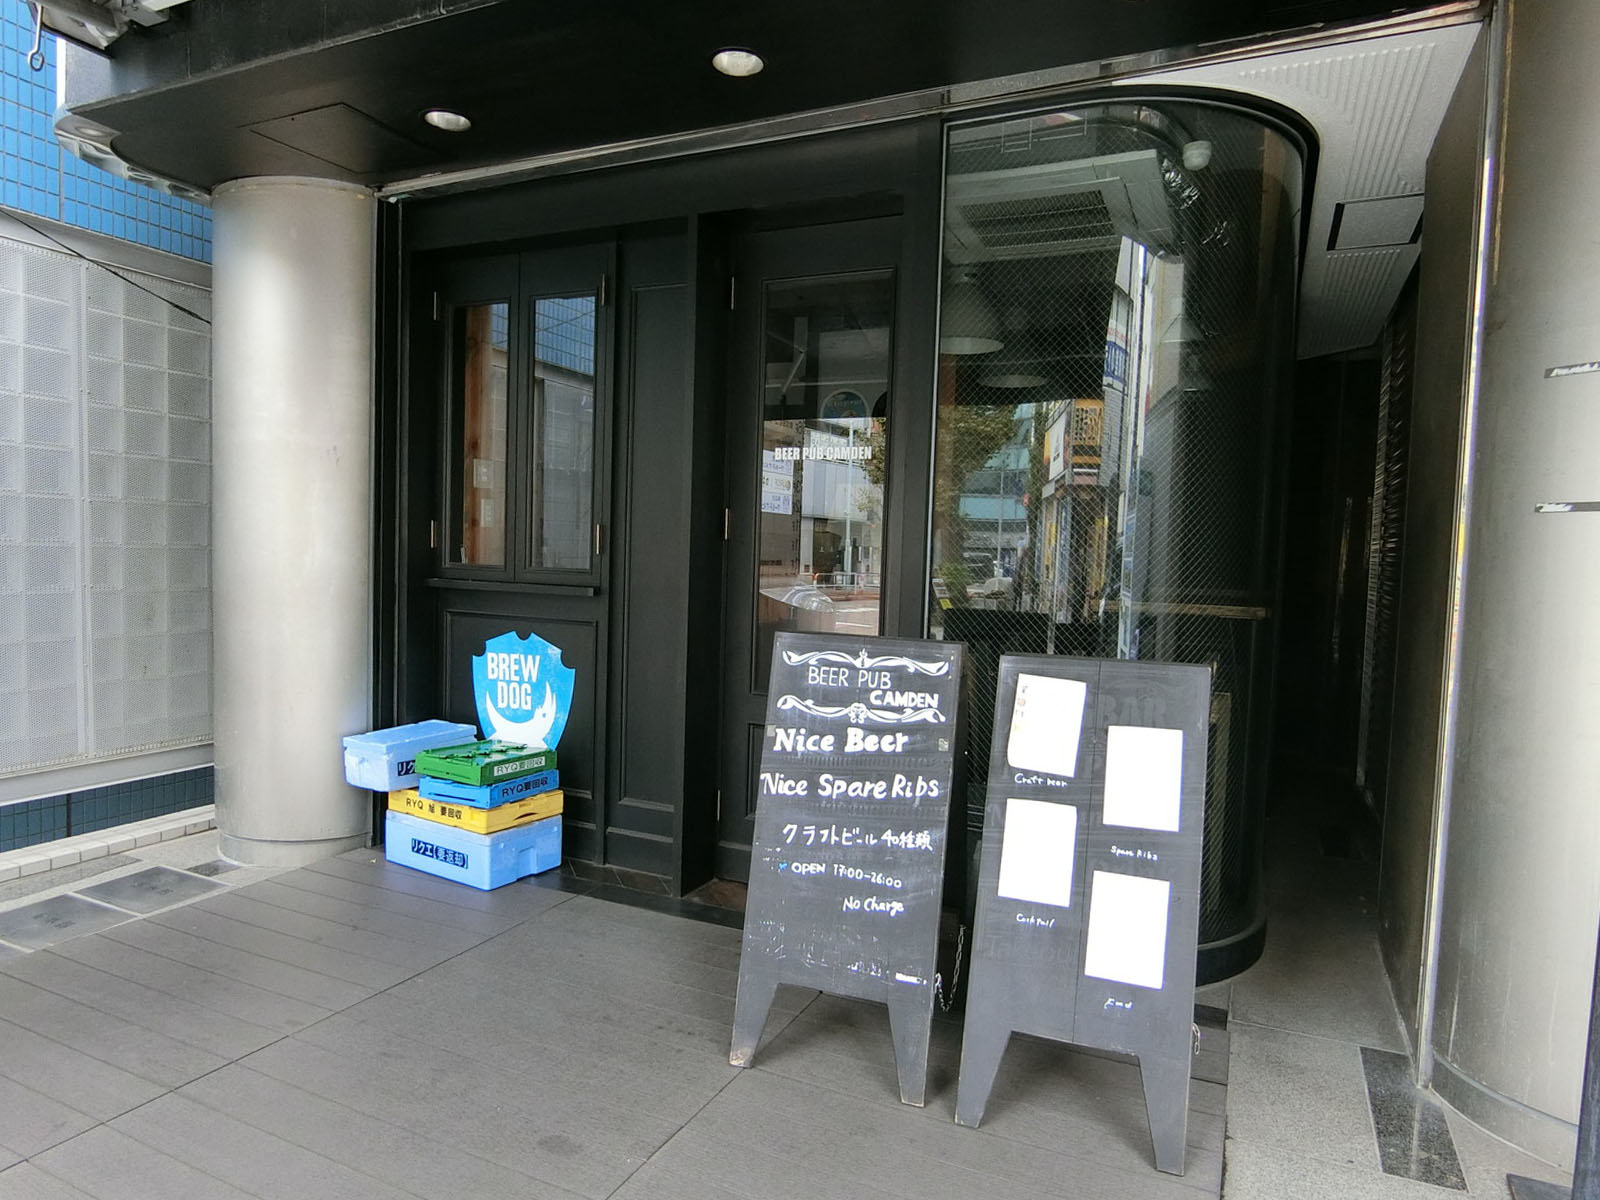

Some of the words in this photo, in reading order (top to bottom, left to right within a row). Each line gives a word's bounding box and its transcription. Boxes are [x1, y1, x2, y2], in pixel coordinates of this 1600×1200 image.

[774, 447, 800, 461] BEER
[802, 446, 824, 460] PUB
[826, 446, 873, 460] CAMDEN
[487, 652, 541, 683] BREW
[808, 666, 849, 688] BEER
[858, 668, 892, 689] PUB
[496, 681, 532, 710] DOG
[869, 689, 939, 708] CAMDEN
[773, 727, 836, 753] Nice
[844, 727, 910, 754] Beer
[760, 772, 808, 797] Nice
[817, 773, 888, 800] Spare
[891, 773, 940, 799] Ribs
[406, 797, 424, 810] RYQ
[440, 806, 463, 820] 要回収
[791, 861, 826, 876] OPEN
[842, 895, 861, 913] No
[863, 895, 905, 918] Charge
